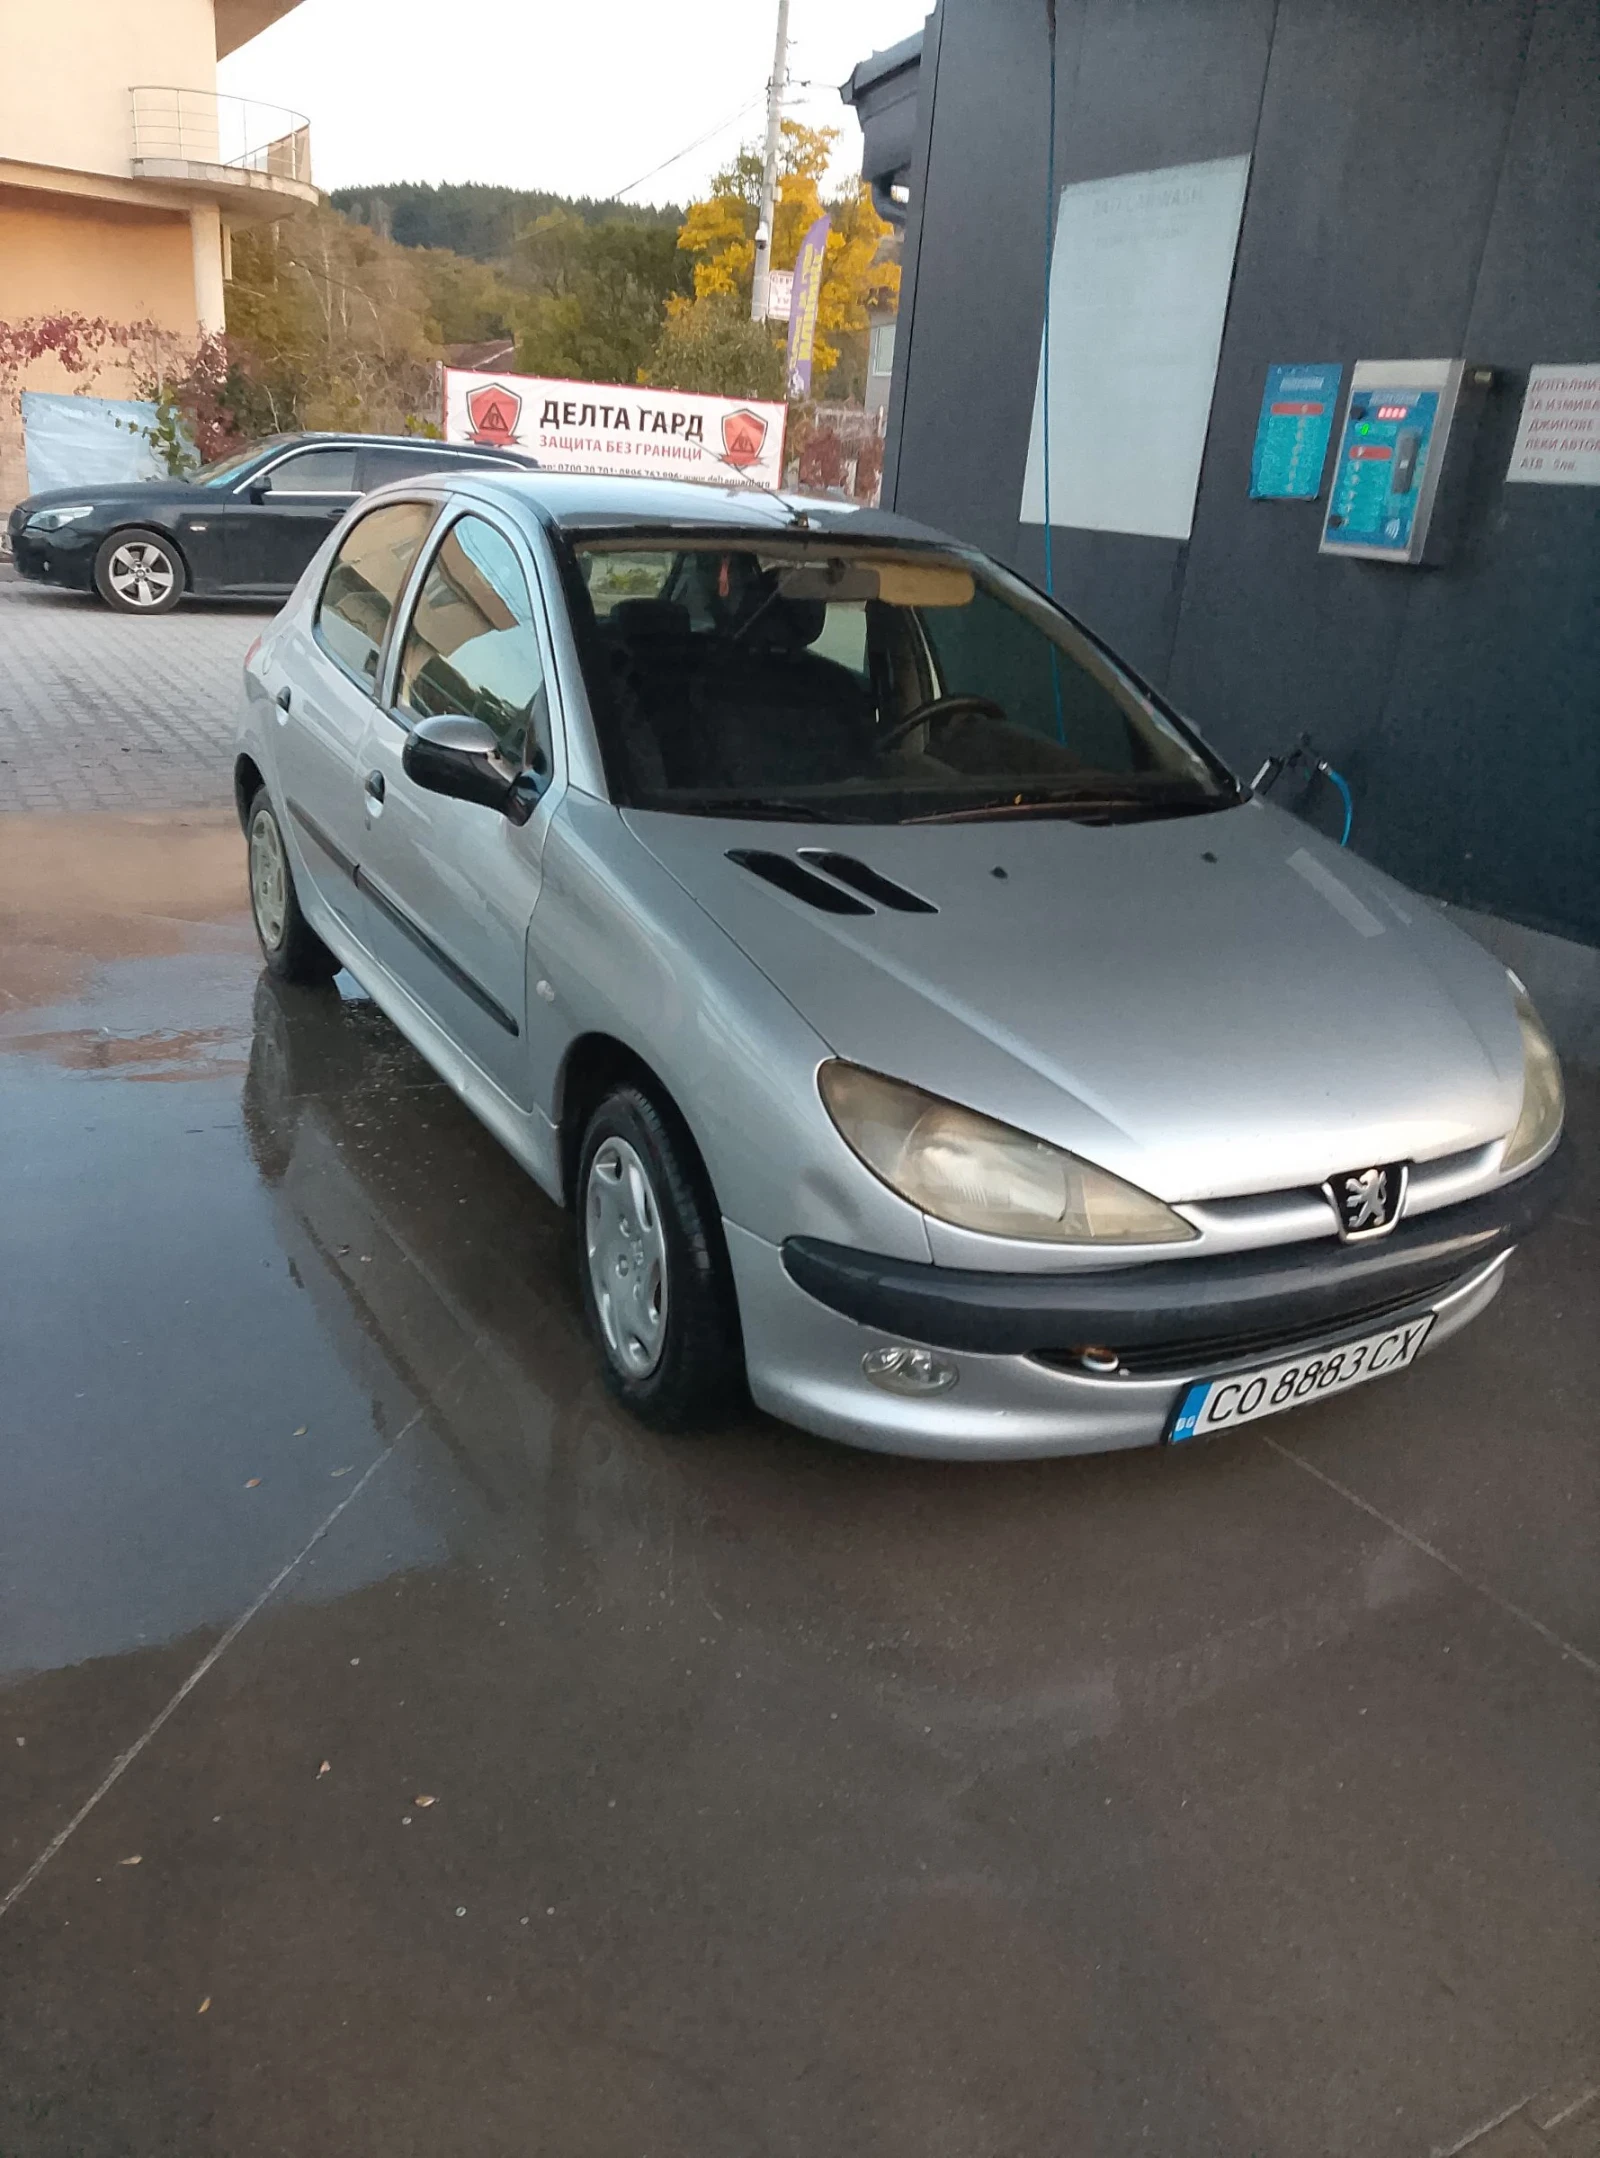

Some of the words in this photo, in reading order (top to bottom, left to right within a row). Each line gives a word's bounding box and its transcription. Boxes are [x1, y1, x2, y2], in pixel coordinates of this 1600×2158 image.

[539, 399, 631, 430] ДЕЛТА
[638, 408, 704, 442] ГАРД
[539, 434, 602, 454] ЗАЩИТА
[605, 440, 632, 455] БЕЗ
[635, 442, 703, 461] ГРАНИЦИ
[1206, 1377, 1267, 1423] CO
[1270, 1345, 1367, 1406] 8883
[1367, 1322, 1426, 1372] CX
